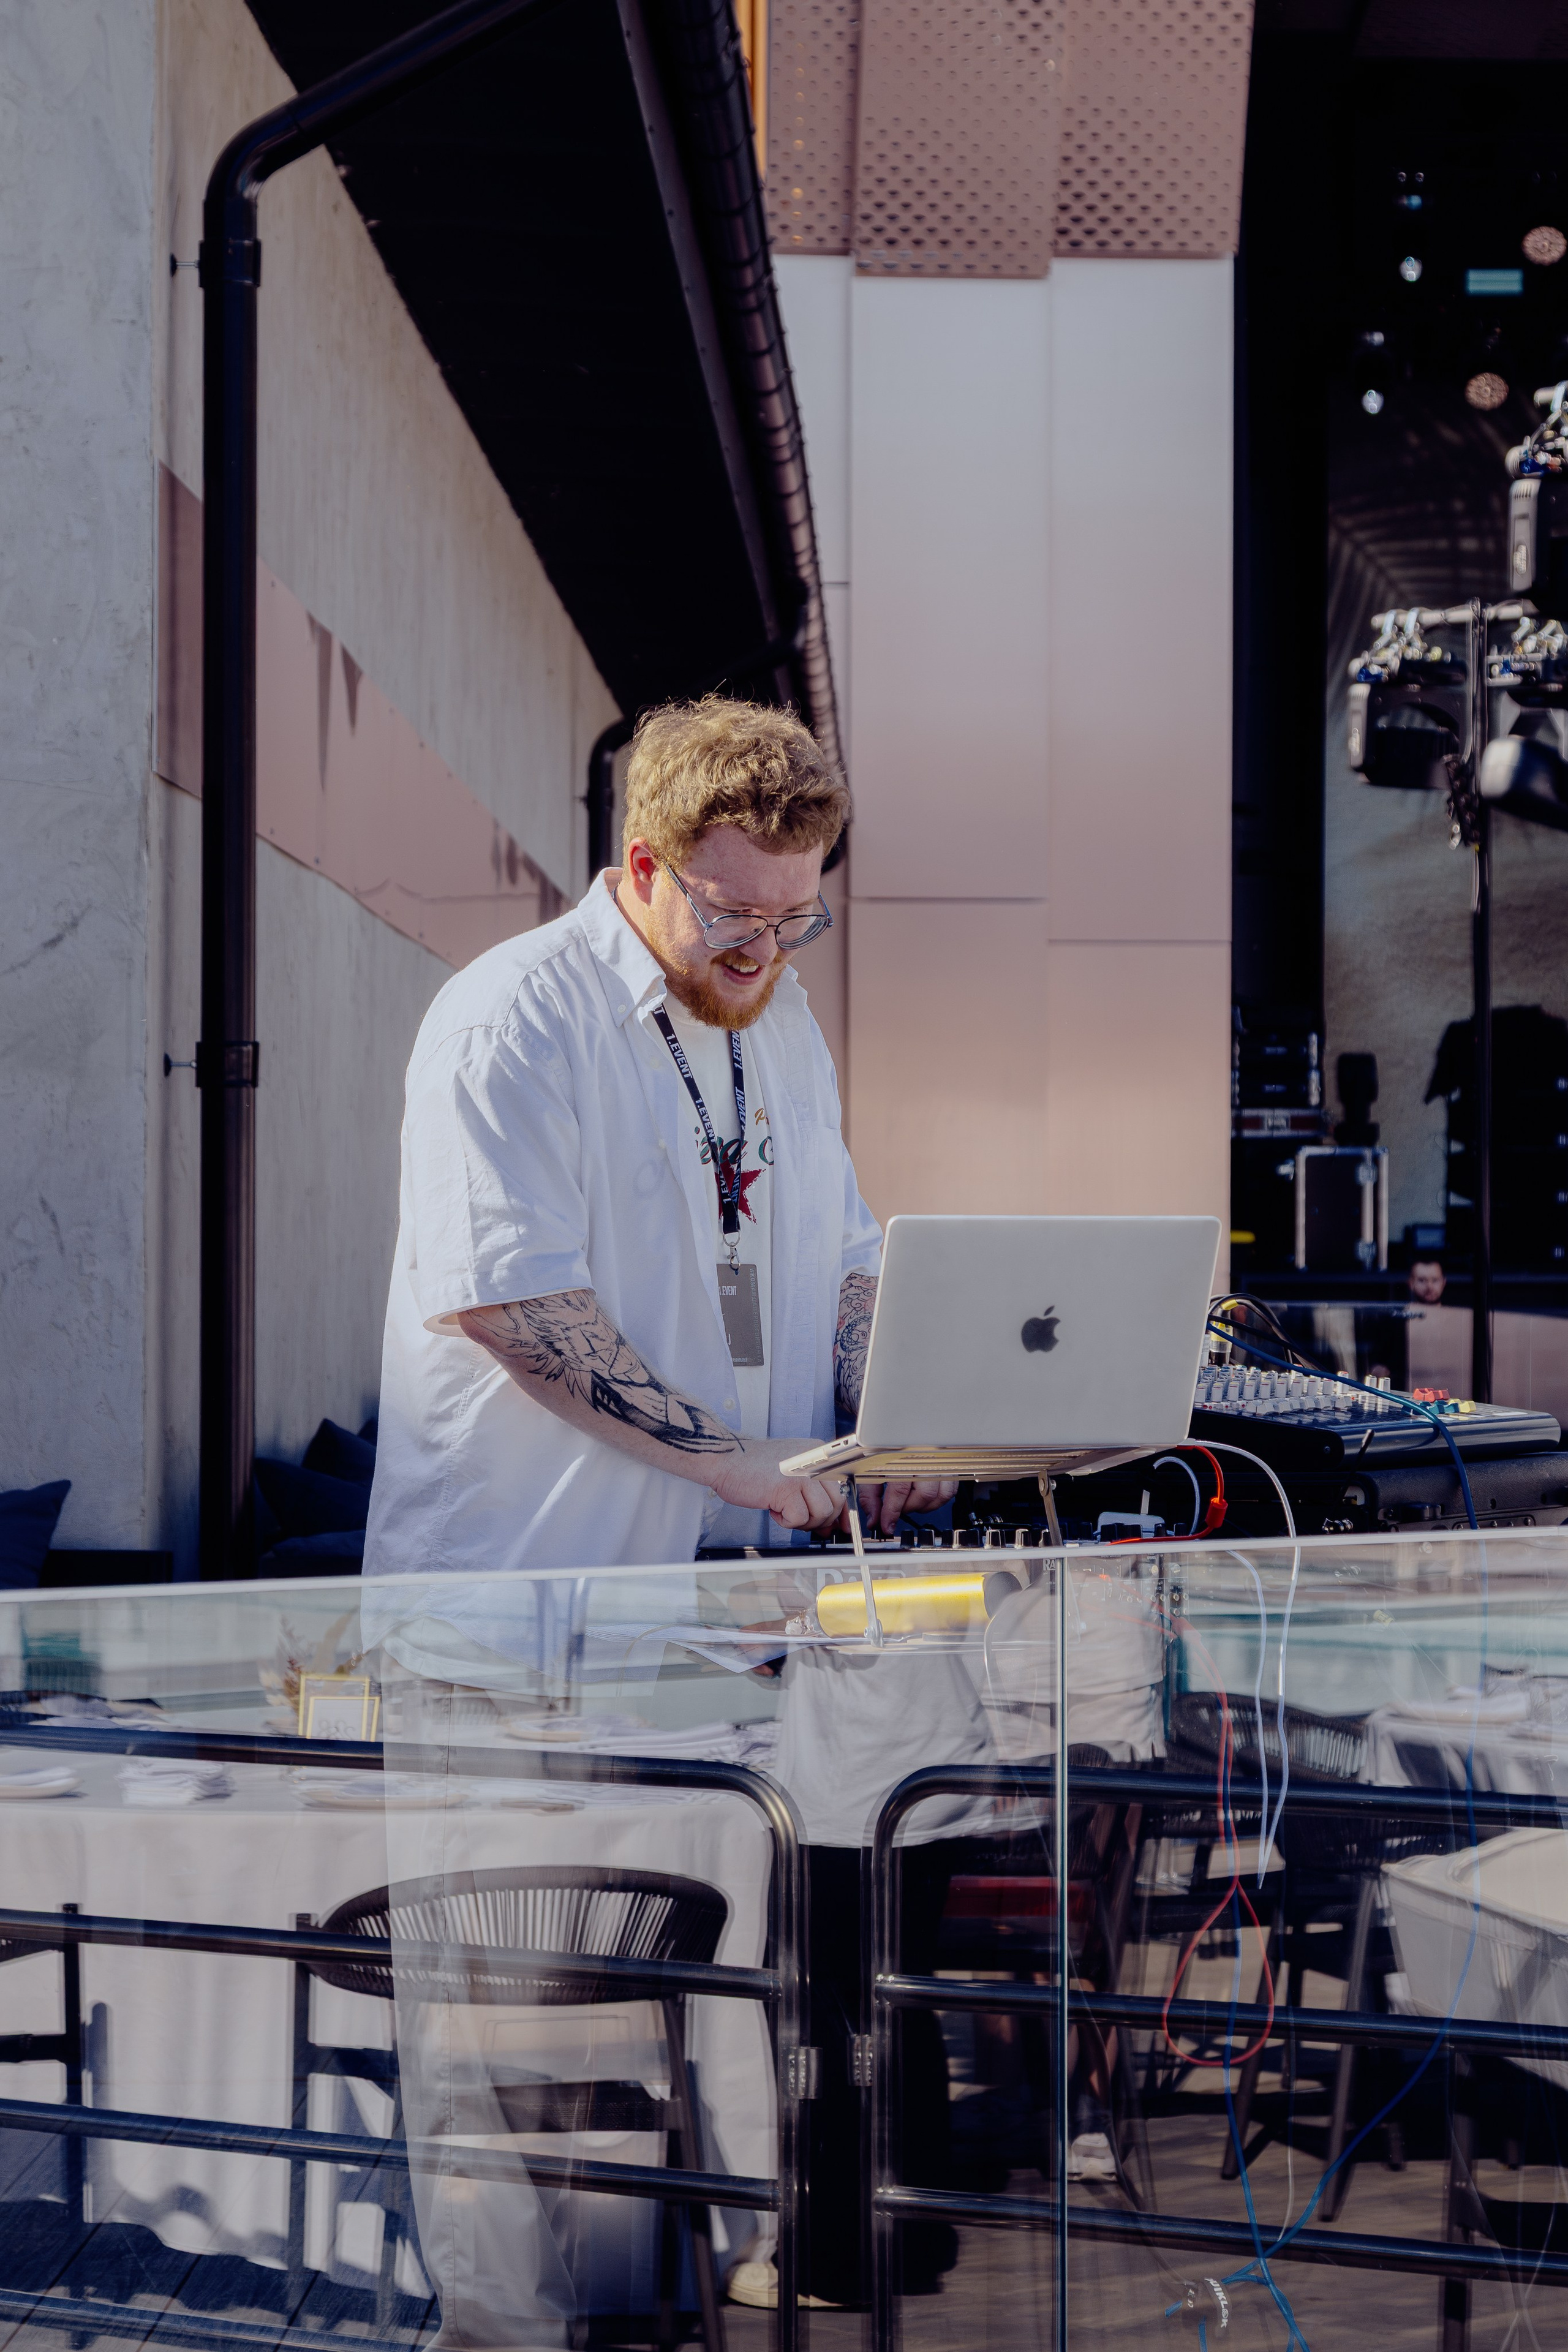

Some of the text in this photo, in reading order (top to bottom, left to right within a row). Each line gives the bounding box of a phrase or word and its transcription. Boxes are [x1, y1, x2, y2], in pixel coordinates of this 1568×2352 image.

[666, 1033, 693, 1079] 1.EVENT
[731, 1027, 742, 1070] 1.EVEN
[695, 1098, 717, 1143] 1.EVENT
[718, 1286, 737, 1296] 1.EVENT
[1042, 1558, 1056, 1570] RA
